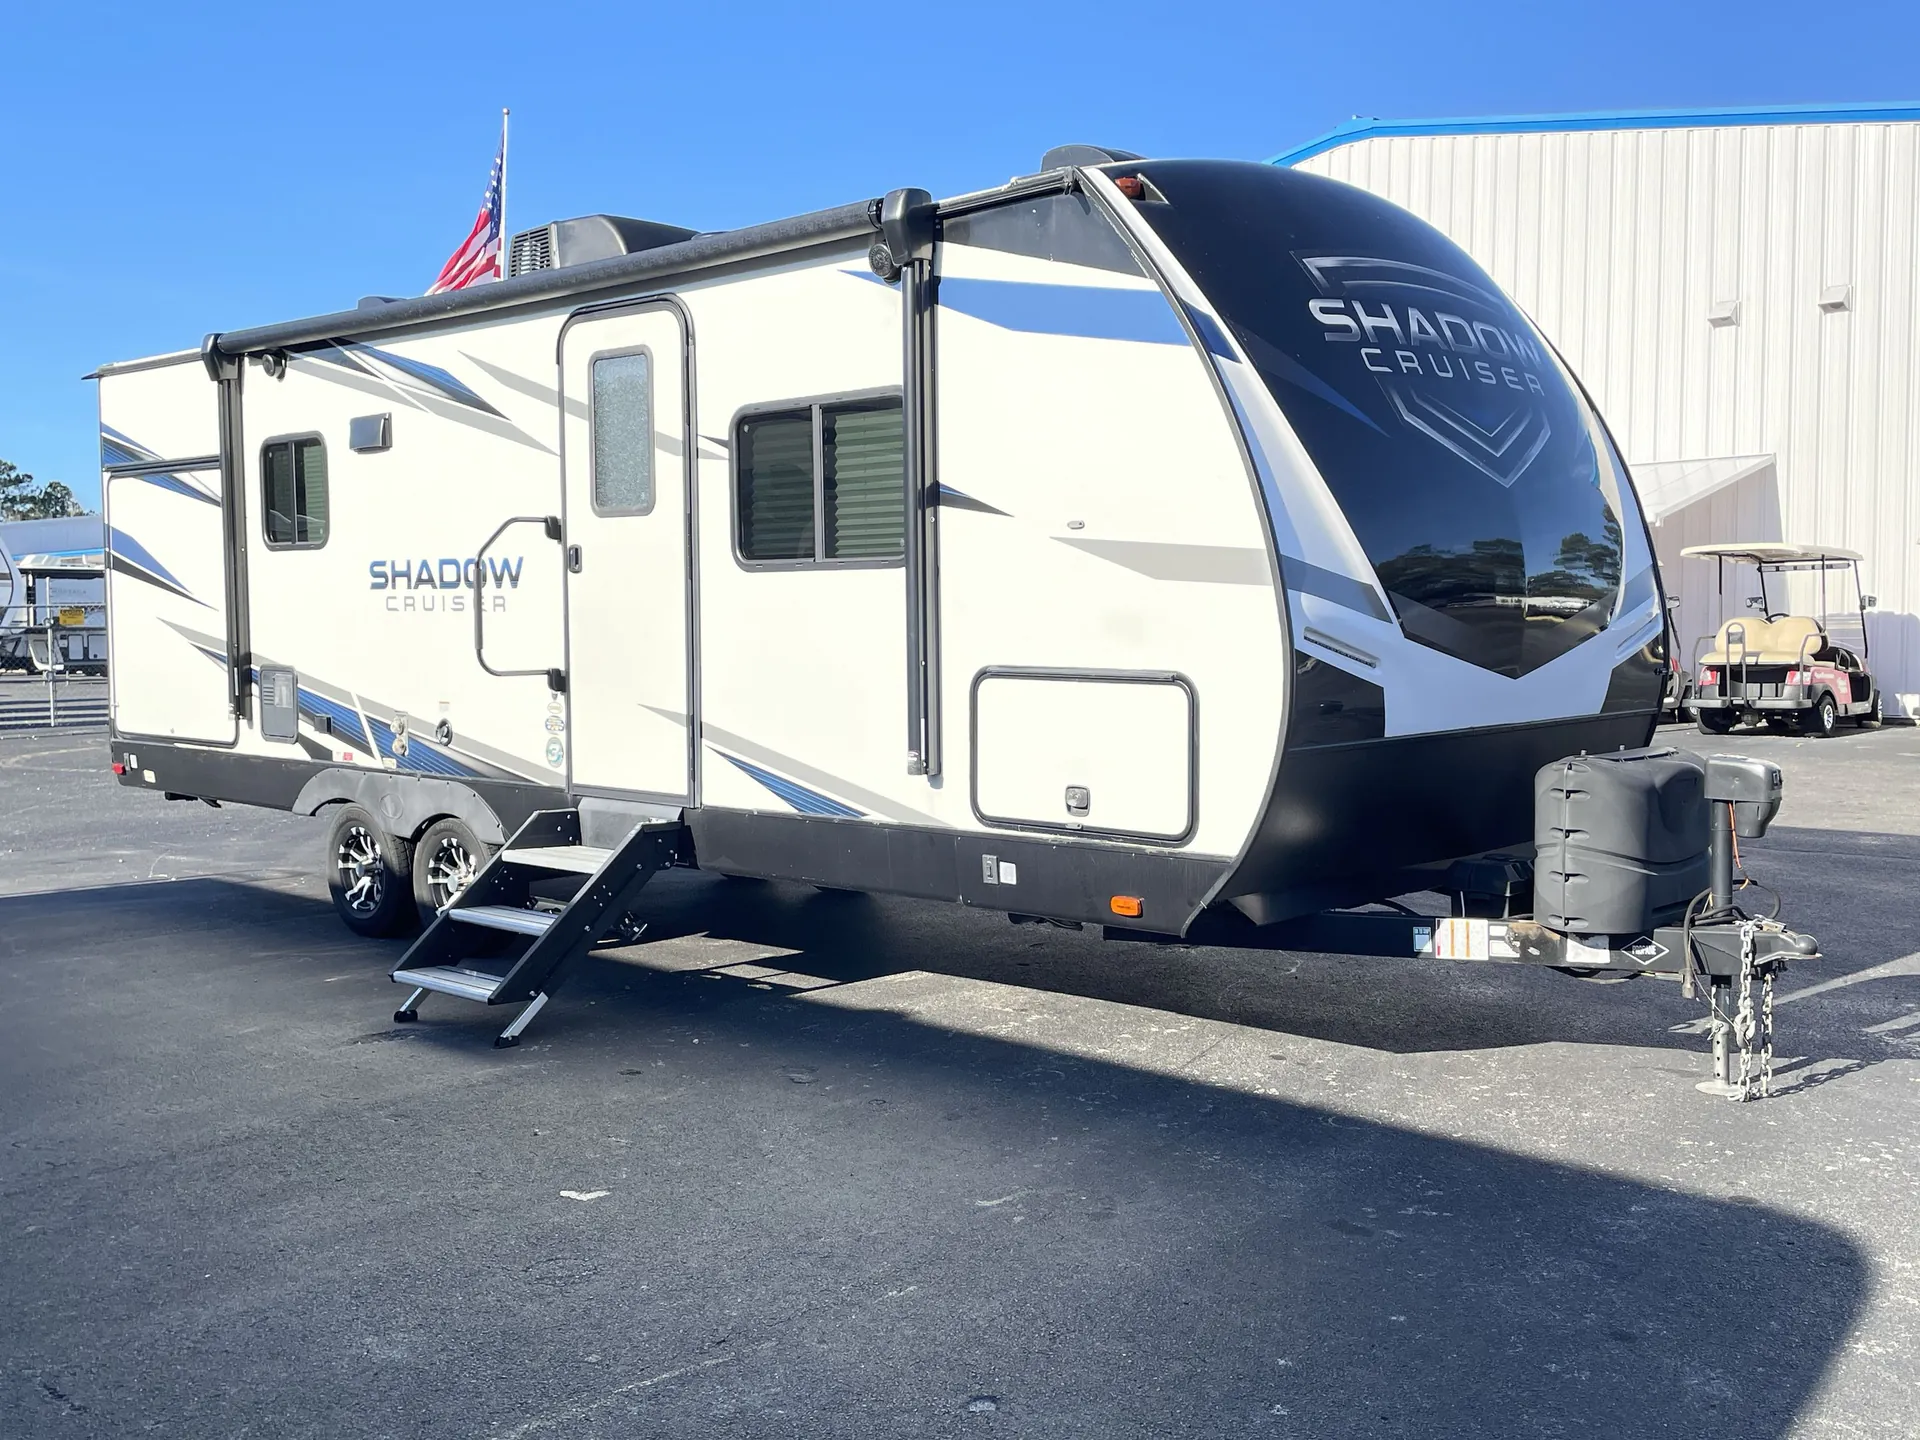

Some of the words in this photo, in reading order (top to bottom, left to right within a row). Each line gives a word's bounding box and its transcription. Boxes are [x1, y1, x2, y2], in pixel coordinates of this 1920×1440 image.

[1308, 298, 1543, 367] SHADOW
[1361, 347, 1545, 397] CRUISER
[369, 556, 524, 590] SHADOW
